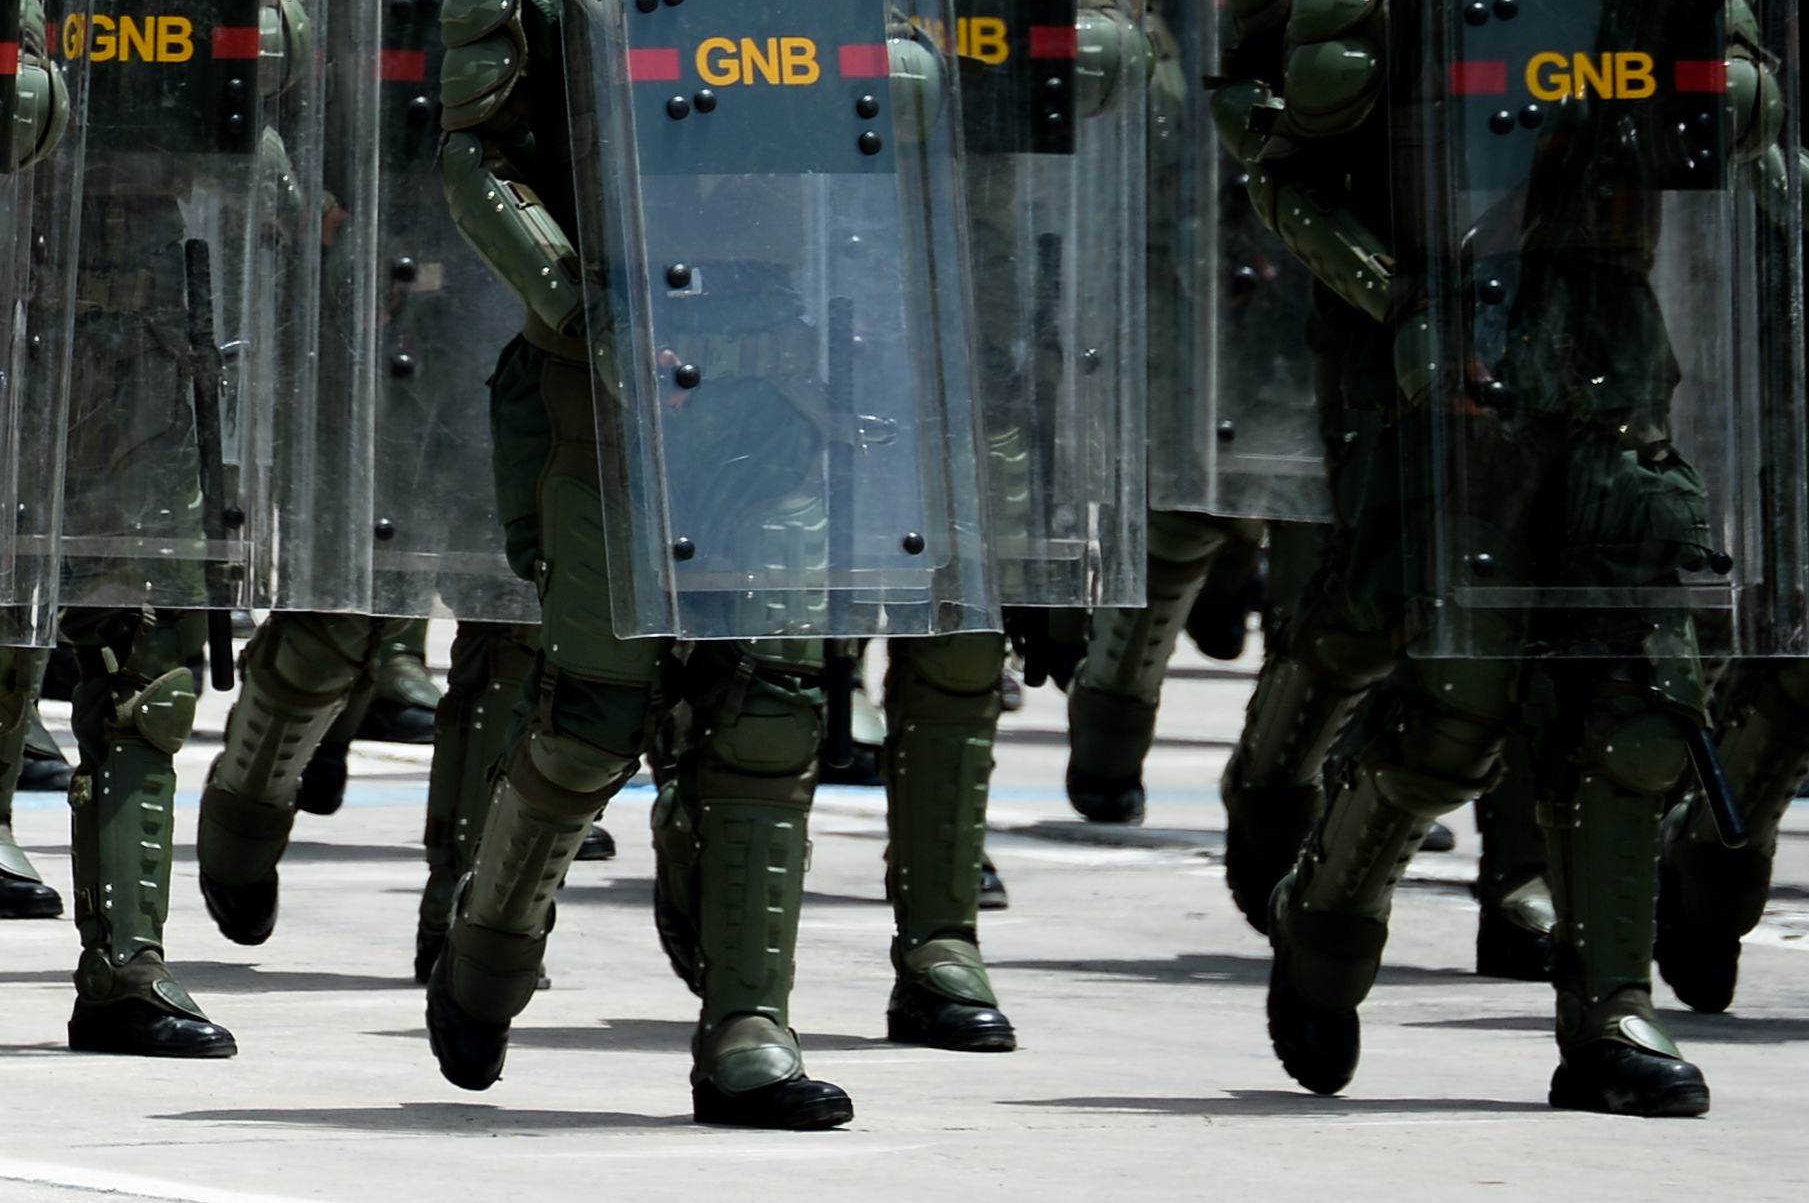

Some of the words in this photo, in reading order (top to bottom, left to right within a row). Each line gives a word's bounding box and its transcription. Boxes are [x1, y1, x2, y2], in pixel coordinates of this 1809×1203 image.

[90, 13, 194, 63] GNB
[695, 36, 821, 87] GNB
[1525, 52, 1657, 101] GNB
